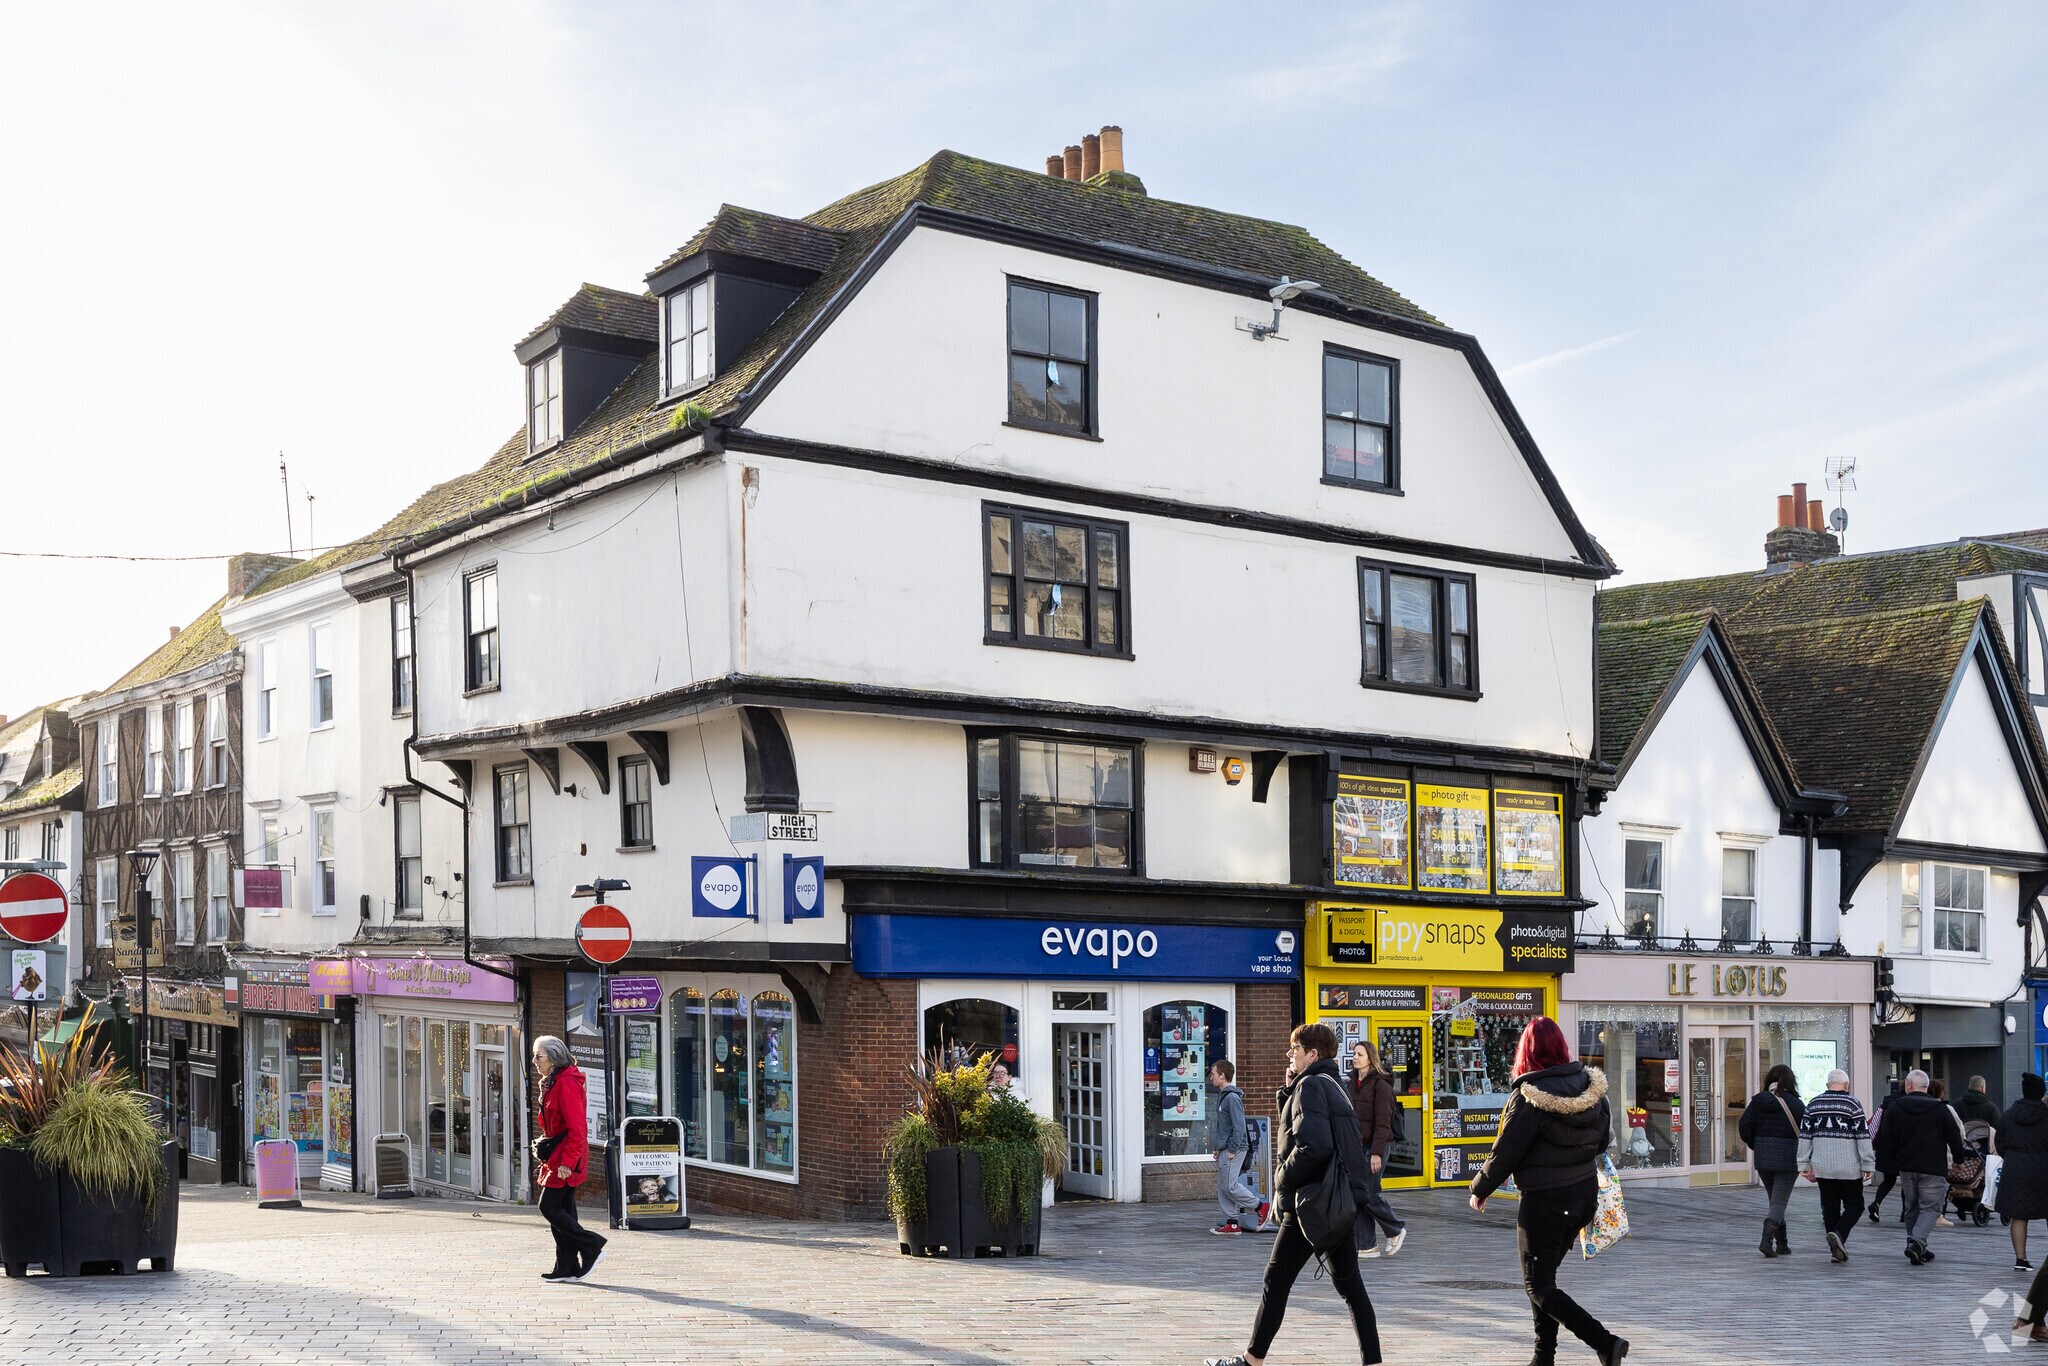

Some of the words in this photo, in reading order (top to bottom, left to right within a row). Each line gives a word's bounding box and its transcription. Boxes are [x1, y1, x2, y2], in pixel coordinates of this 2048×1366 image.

[1198, 754, 1214, 762] ABEL
[1358, 783, 1366, 792] gift
[1367, 784, 1379, 792] ideas
[1431, 789, 1454, 800] photo
[1456, 791, 1469, 803] gift
[1506, 797, 1518, 805] ready
[1534, 798, 1546, 806] hour
[780, 815, 806, 827] HIGH
[772, 827, 813, 839] STREET
[1431, 829, 1456, 840] SAME
[1458, 830, 1475, 841] DAY
[1433, 843, 1455, 852] PHOTO
[1456, 844, 1475, 853] GIFTS
[1441, 854, 1446, 863] 3
[1448, 854, 1460, 863] For
[1461, 855, 1467, 864] 2
[704, 883, 739, 895] evapo
[796, 883, 816, 895] evapo
[1378, 921, 1485, 953] ppysnaps
[1041, 926, 1158, 970] evapo
[1339, 947, 1366, 956] PHOTOS
[1511, 943, 1567, 961] specialists
[1257, 955, 1272, 963] your
[1273, 954, 1292, 962] local
[313, 962, 349, 977] Nails
[386, 962, 411, 981] House
[424, 963, 446, 983] Nails
[453, 965, 472, 988] Spa
[1251, 964, 1270, 974] vape
[1272, 963, 1292, 975] shop
[1668, 963, 1698, 996] LE
[1712, 964, 1787, 996] LOTUS
[242, 984, 284, 1010] EUROPEAN
[285, 986, 320, 1014] MARKET
[1360, 989, 1375, 998] FILM
[1376, 989, 1415, 998] PROCESSING
[1471, 992, 1514, 1000] PERSONALISED
[1515, 992, 1532, 1000] GIFTS
[196, 991, 212, 1016] Hub
[1354, 999, 1376, 1007] COLOUR
[570, 1045, 591, 1055] UPGRADES
[1464, 1114, 1490, 1122] INSTANT
[1490, 1113, 1502, 1121] PHO
[1468, 1152, 1490, 1160] INSTAN
[1468, 1162, 1484, 1171] PASS
